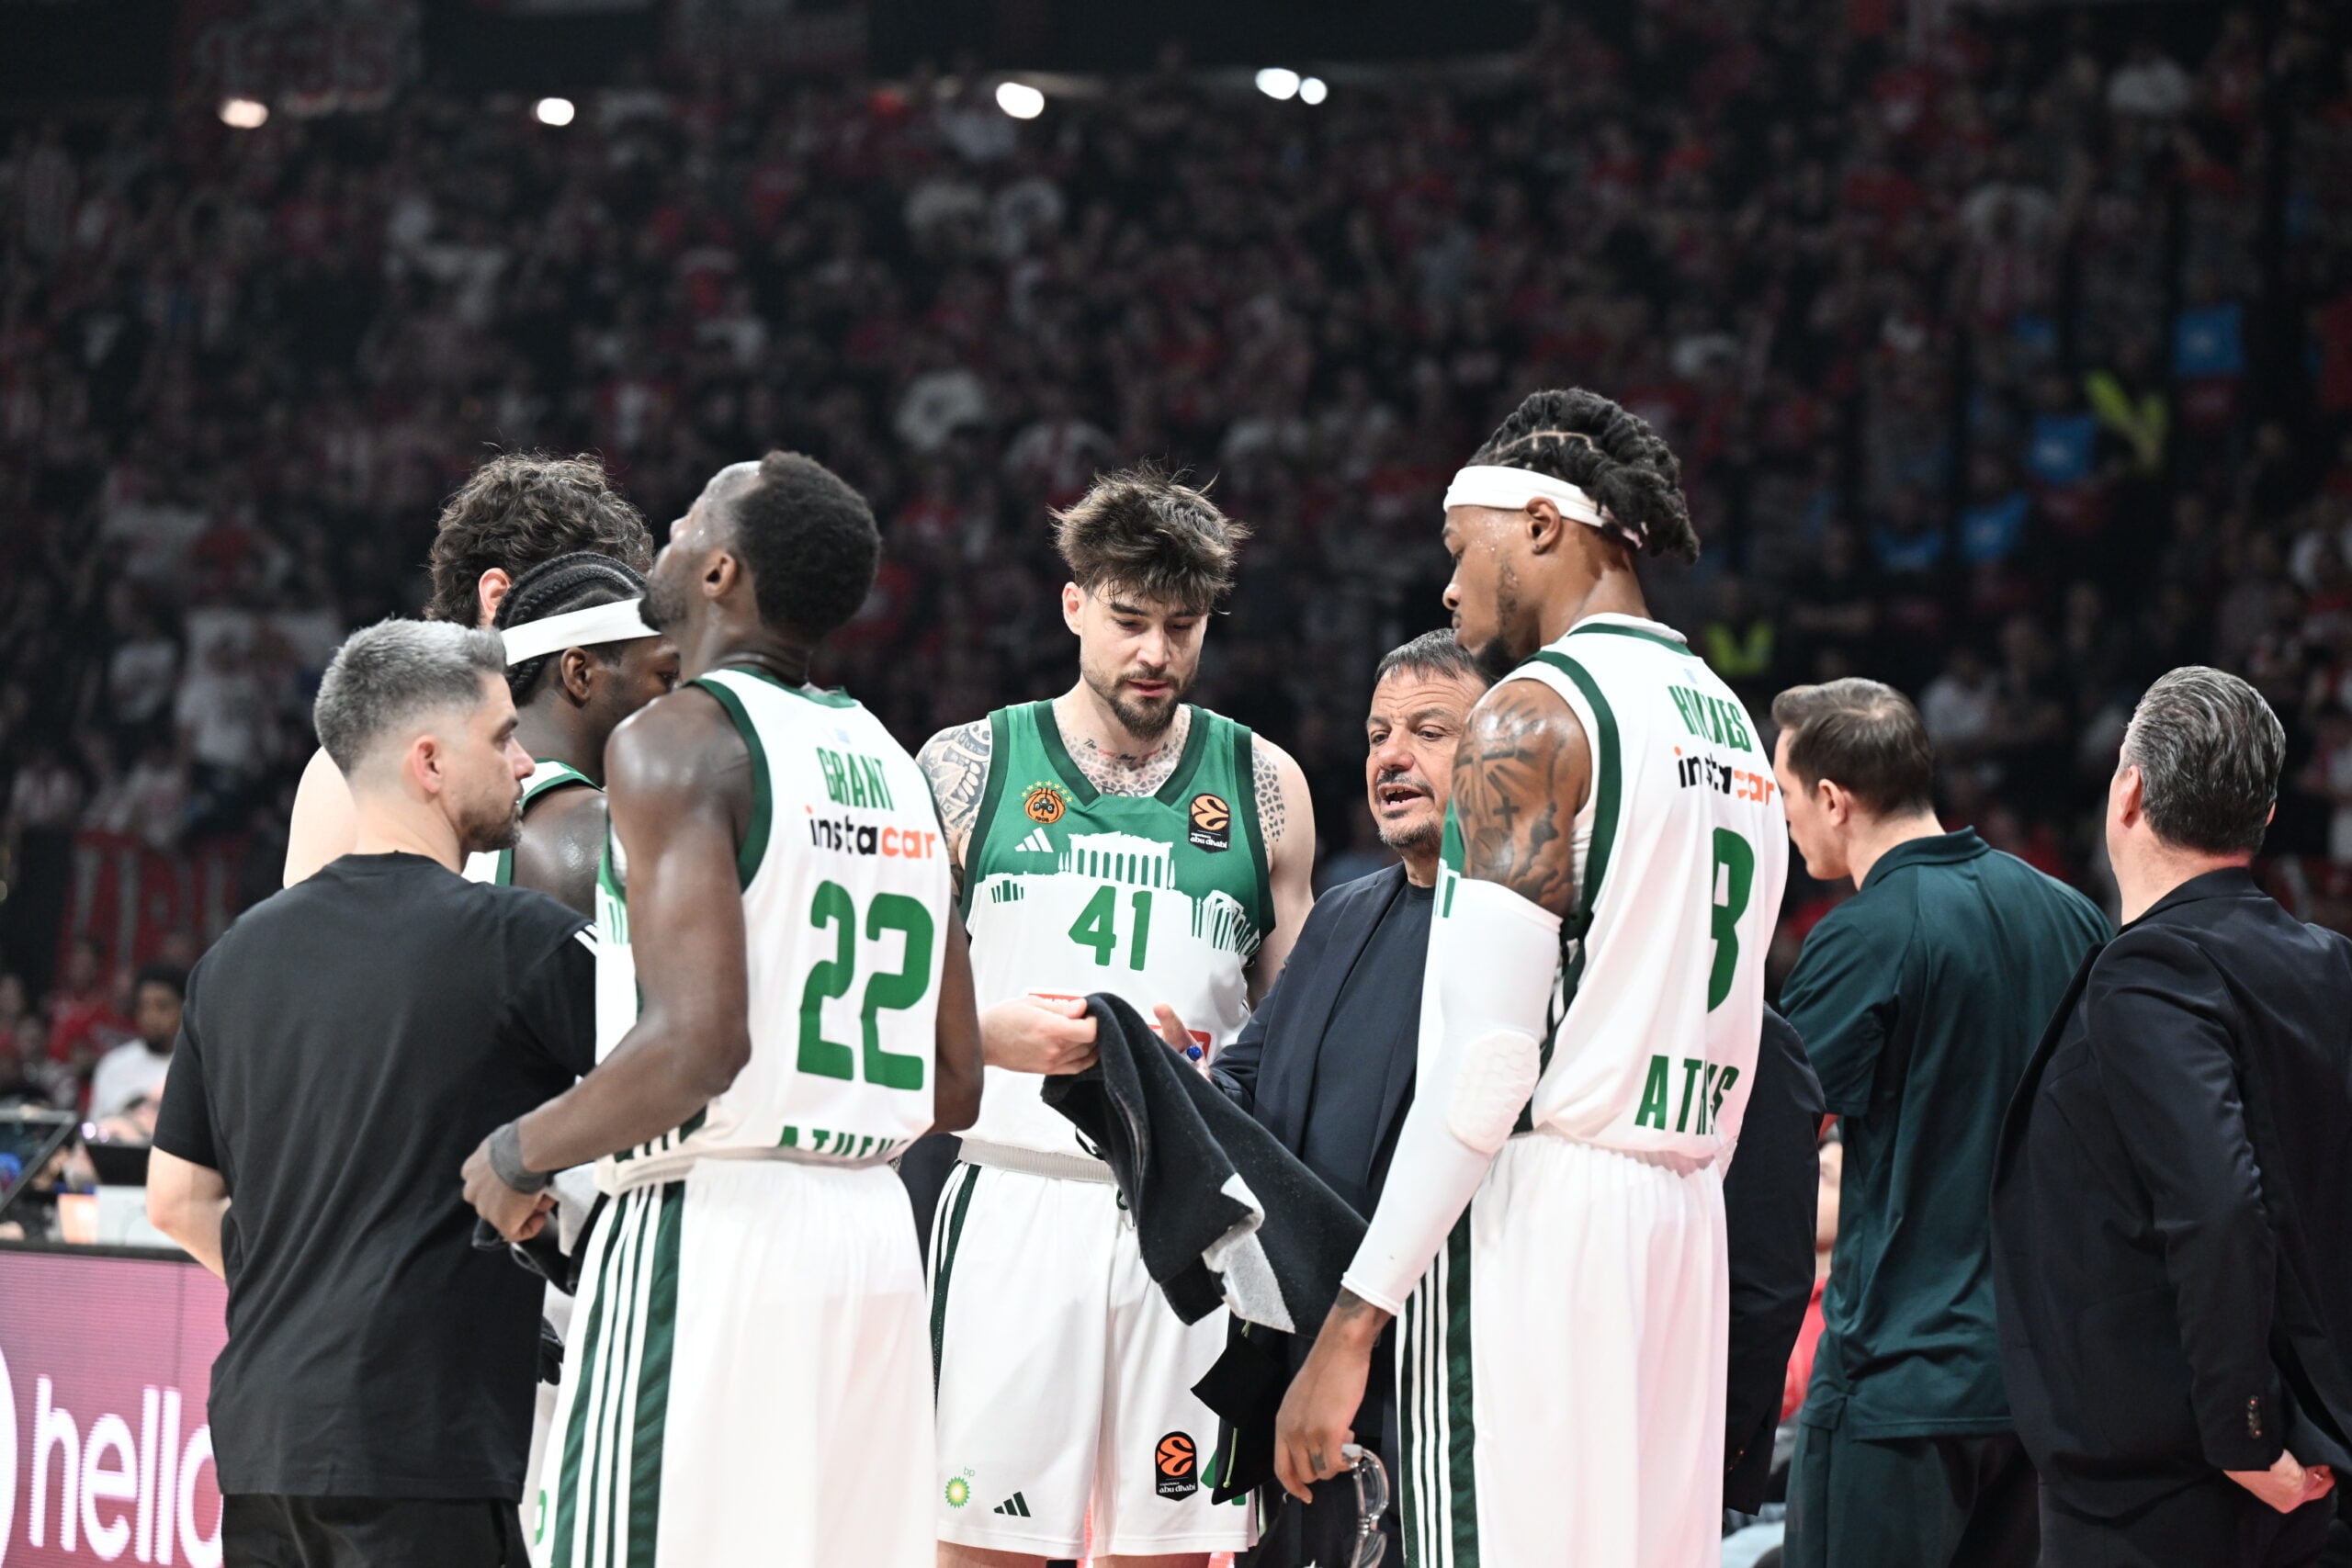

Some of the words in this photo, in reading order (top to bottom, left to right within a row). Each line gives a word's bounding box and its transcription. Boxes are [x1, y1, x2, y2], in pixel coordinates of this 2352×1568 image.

[816, 746, 895, 812] GRANT
[805, 805, 936, 860] instacar
[1190, 836, 1204, 844] abu
[1068, 885, 1153, 972] 41
[797, 879, 934, 1091] 22
[963, 1466, 976, 1478] bp
[1159, 1484, 1174, 1494] abu
[1175, 1483, 1196, 1493] dhabi
